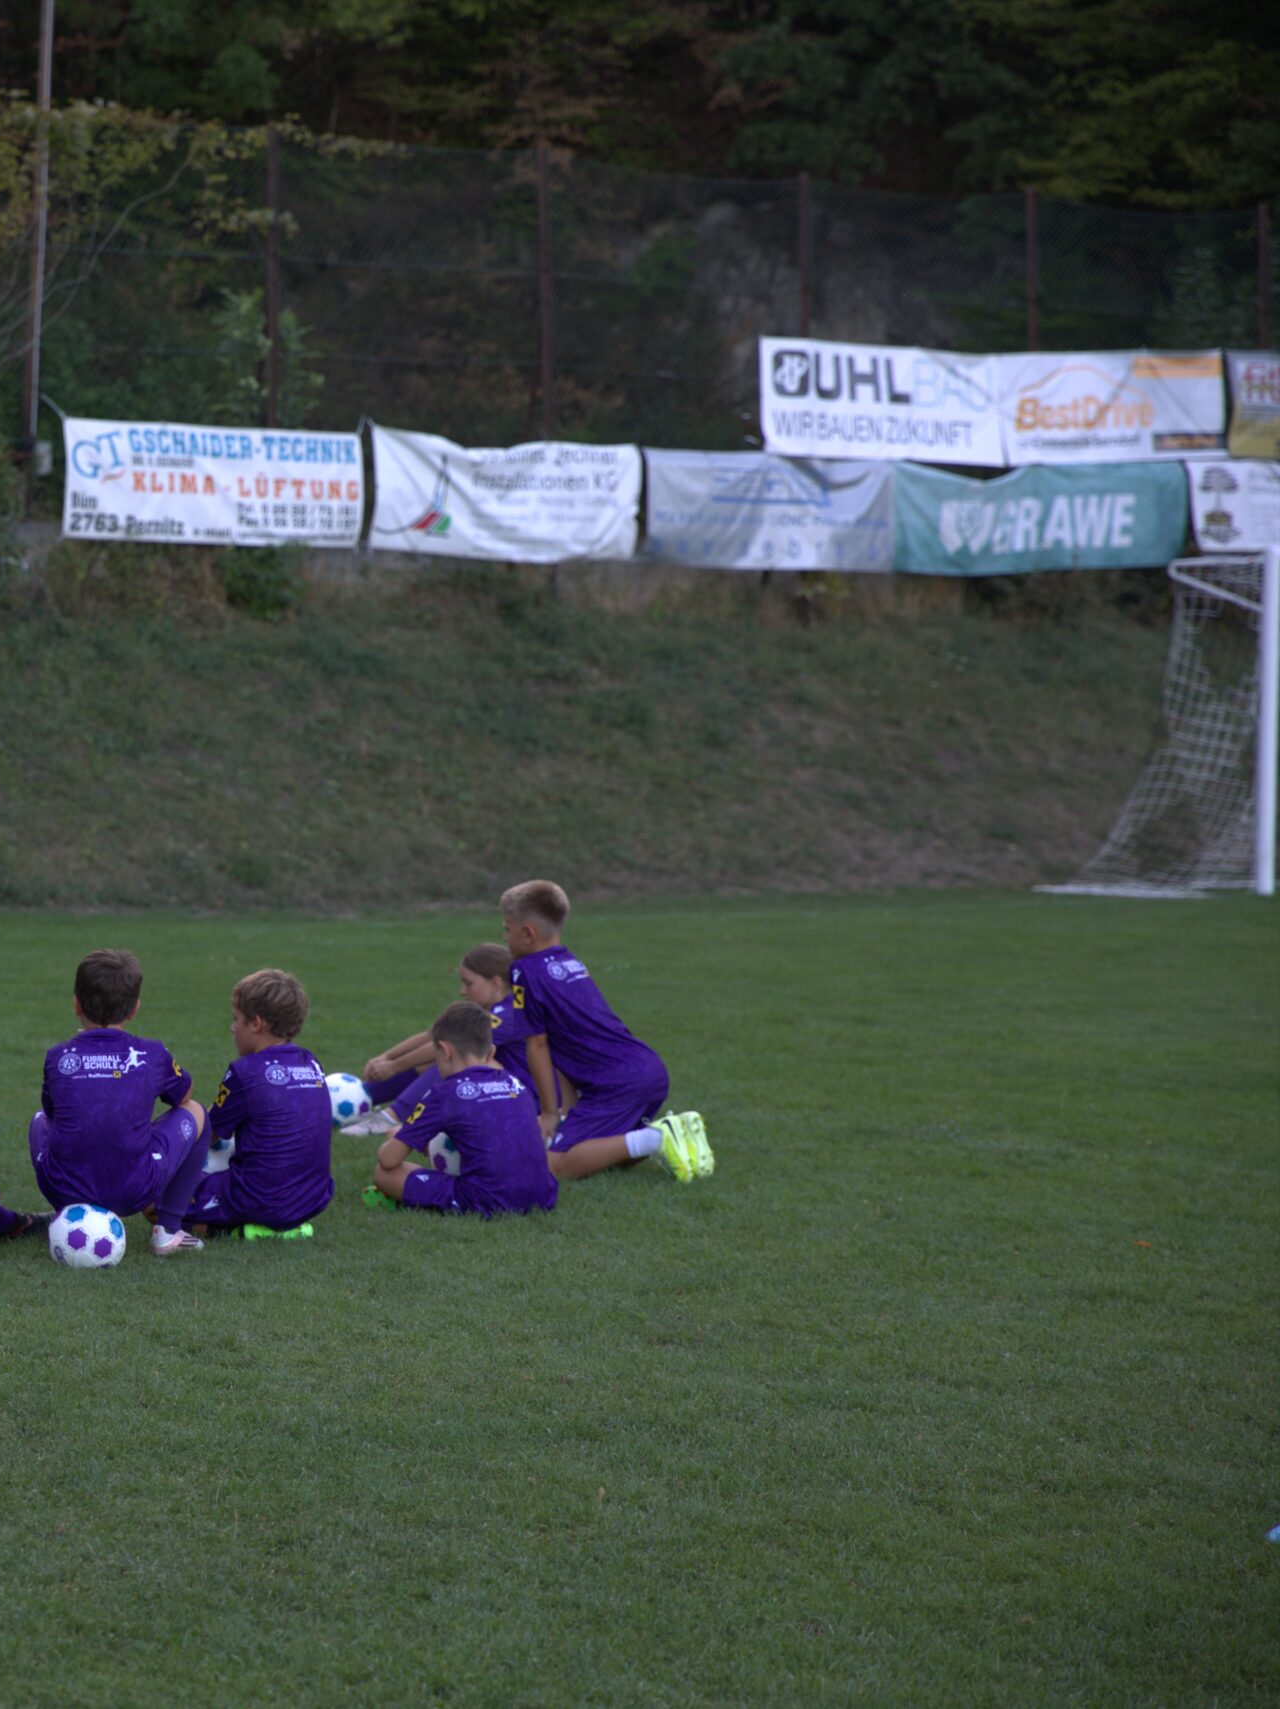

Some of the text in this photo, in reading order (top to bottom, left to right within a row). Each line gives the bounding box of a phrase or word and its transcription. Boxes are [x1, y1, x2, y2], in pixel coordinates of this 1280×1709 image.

[1015, 395, 1155, 432] BestDrive
[772, 411, 973, 447] WIR BAUEN ZUKUNFT
[132, 472, 216, 495] KLIMA
[237, 474, 360, 501] LÜFTUNG
[82, 1054, 121, 1063] FUSSBALL
[84, 1062, 118, 1070] SCHULE
